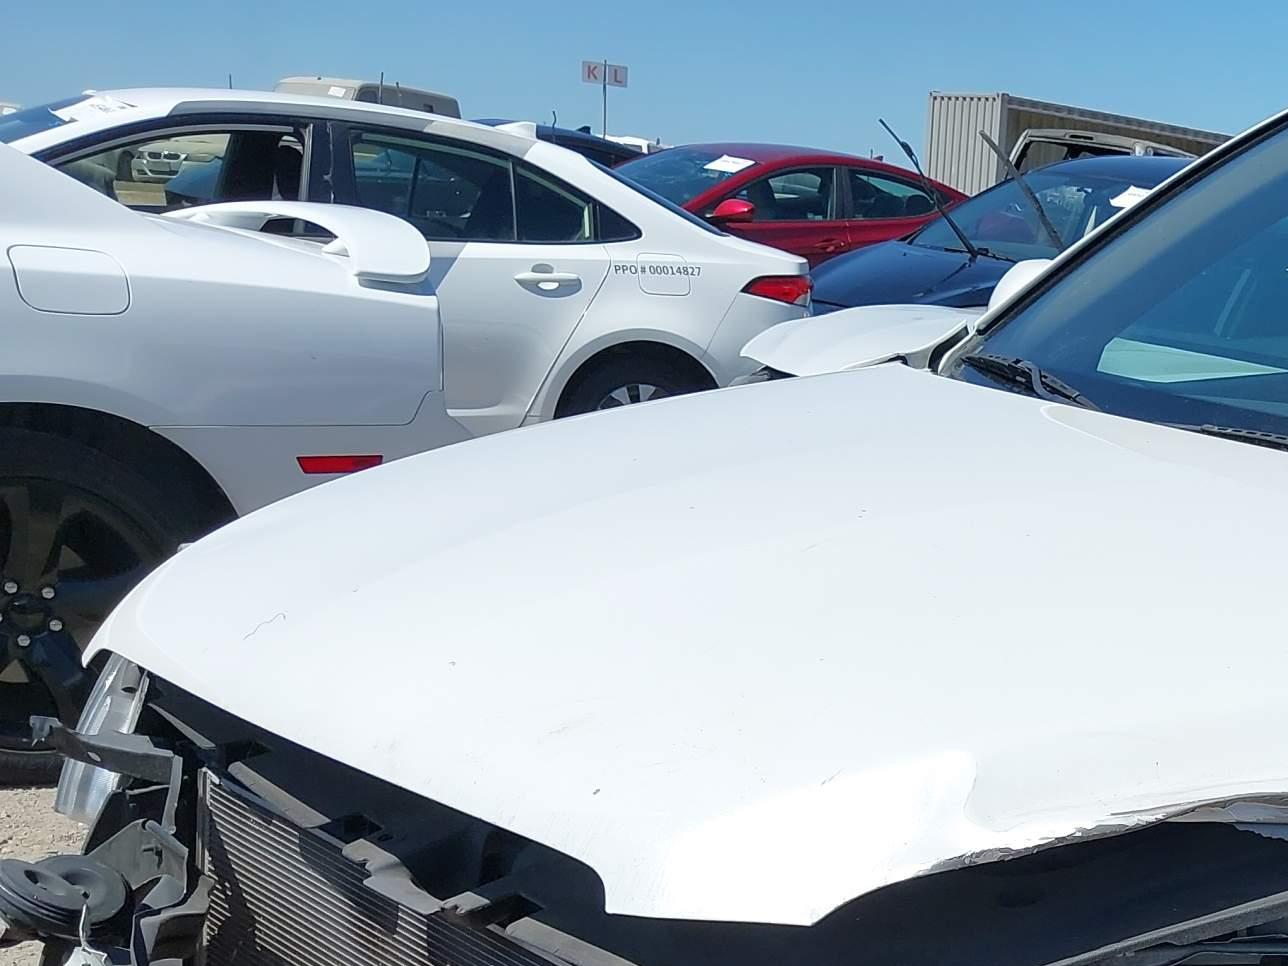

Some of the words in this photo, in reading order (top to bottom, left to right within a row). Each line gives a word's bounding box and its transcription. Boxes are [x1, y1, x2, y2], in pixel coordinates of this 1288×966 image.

[587, 64, 598, 80] K
[614, 68, 624, 84] L
[614, 264, 638, 275] PPO
[640, 265, 647, 275] #
[649, 265, 702, 276] 00014827
